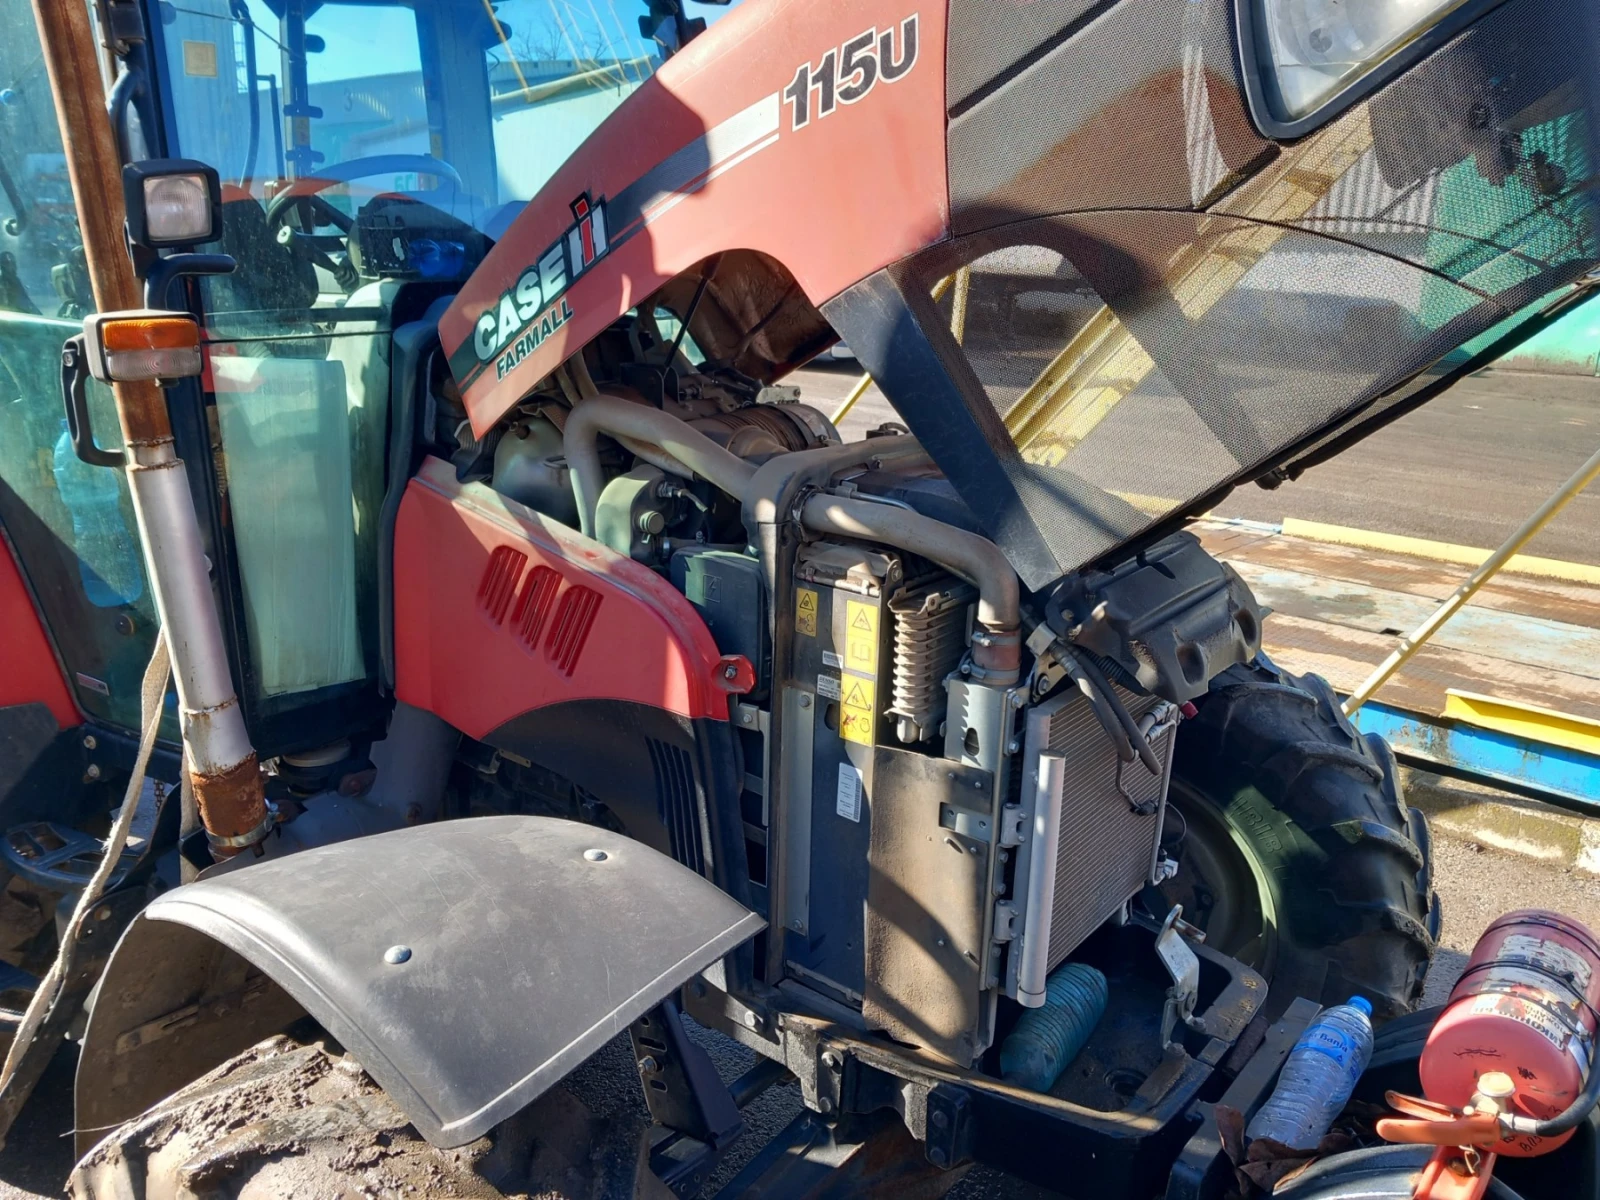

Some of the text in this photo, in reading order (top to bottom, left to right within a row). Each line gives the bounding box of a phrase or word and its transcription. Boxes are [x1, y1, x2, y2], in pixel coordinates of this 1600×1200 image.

[783, 12, 919, 132] 115U
[473, 241, 568, 362] CASE
[496, 298, 575, 382] FARMALL
